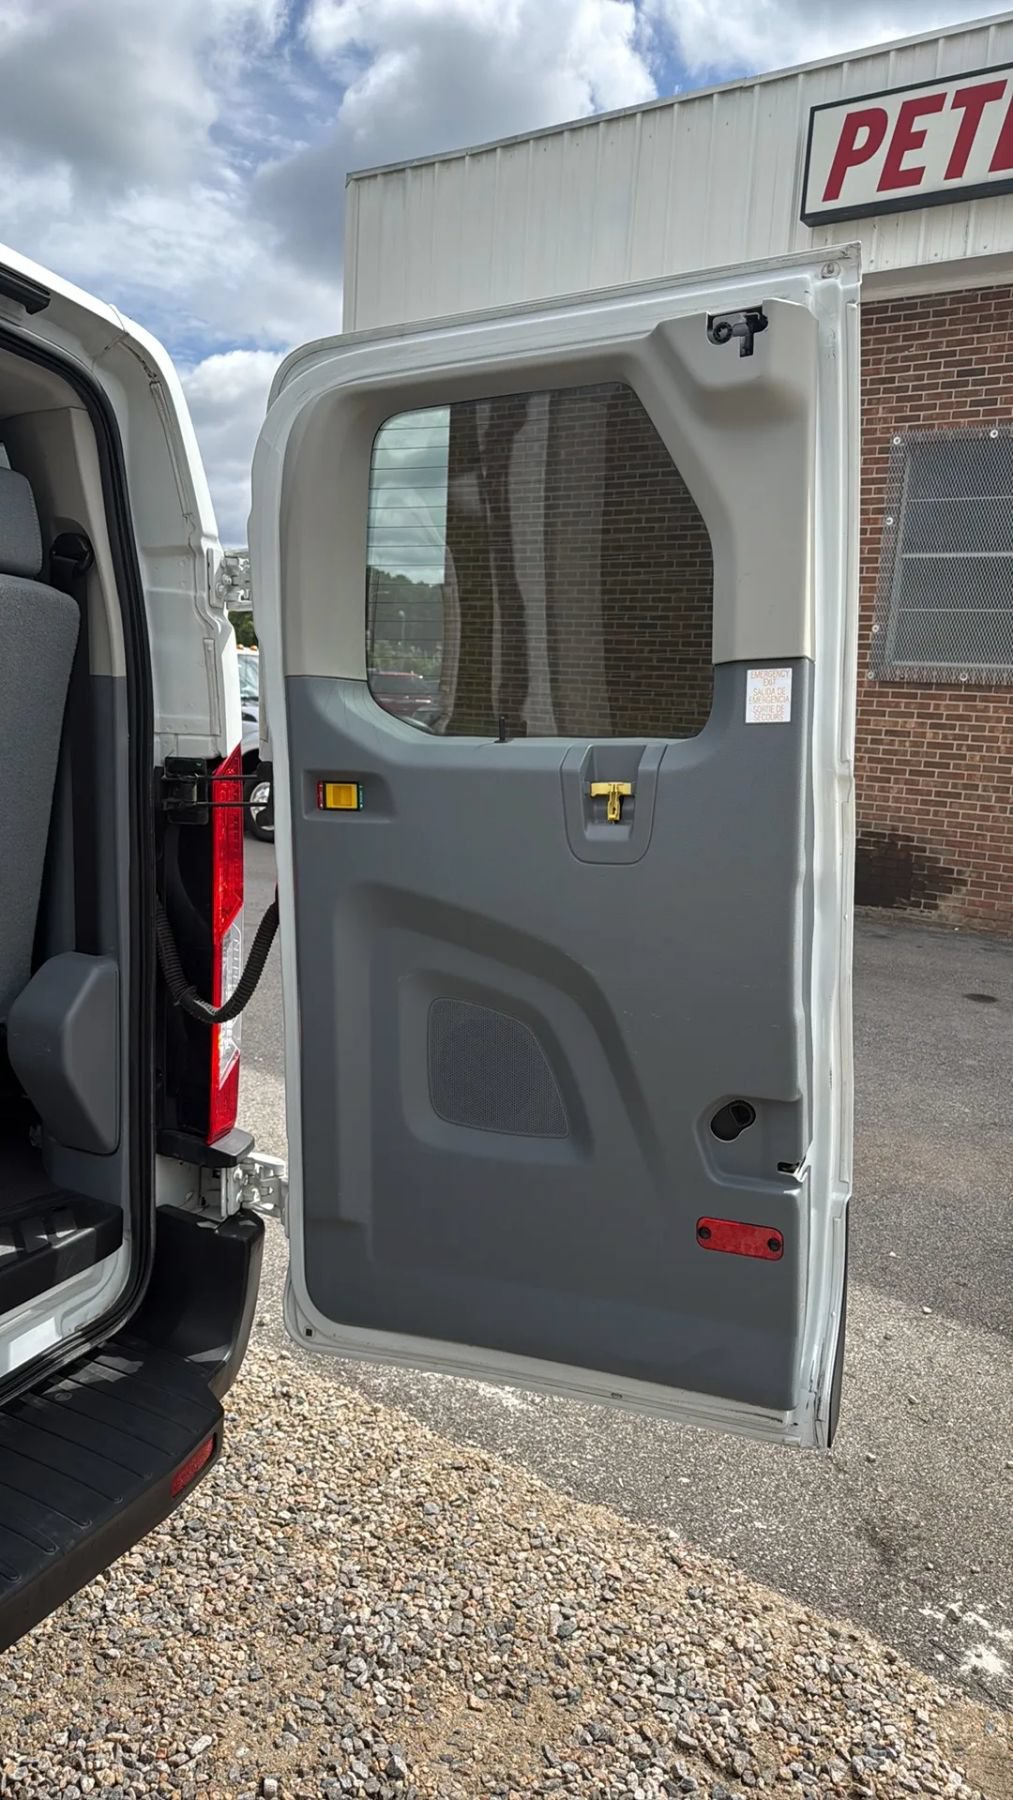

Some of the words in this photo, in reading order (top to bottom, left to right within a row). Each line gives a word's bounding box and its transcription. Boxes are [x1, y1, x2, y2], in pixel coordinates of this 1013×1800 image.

[751, 670, 790, 679] EMERGENCY
[763, 679, 776, 687] EXIT
[753, 688, 776, 696] SALIDA
[777, 687, 786, 695] DE
[749, 695, 790, 704] EMERGENCIA
[753, 705, 775, 714] SORTIE
[776, 705, 785, 713] DE
[753, 713, 784, 721] SECOURS
